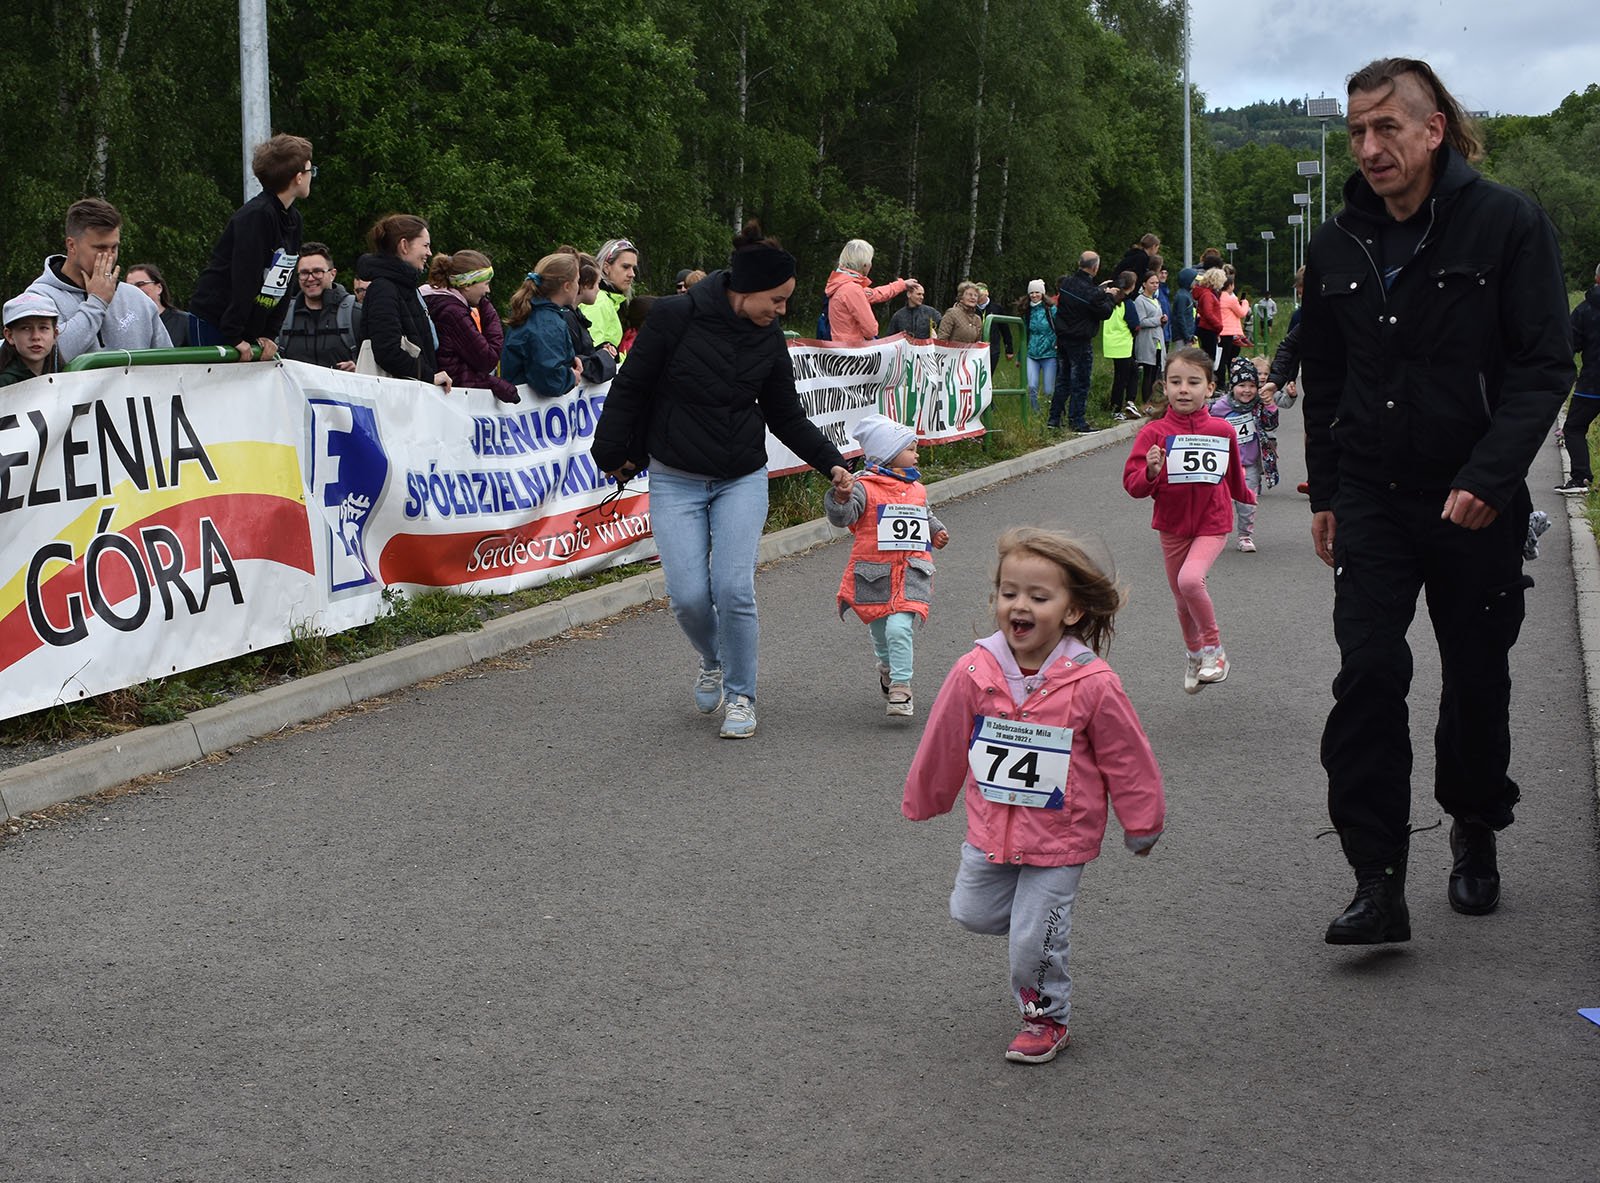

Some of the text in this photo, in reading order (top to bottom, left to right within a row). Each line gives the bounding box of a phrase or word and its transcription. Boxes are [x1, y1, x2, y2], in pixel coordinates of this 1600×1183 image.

[1183, 450, 1218, 473] 56
[405, 462, 562, 518] SPÓŁDZIELNIA
[466, 520, 591, 573] Serdecznie
[892, 518, 922, 541] 92
[26, 508, 244, 647] GÓRA
[986, 745, 1040, 788] 74
[1043, 905, 1065, 956] Minnie
